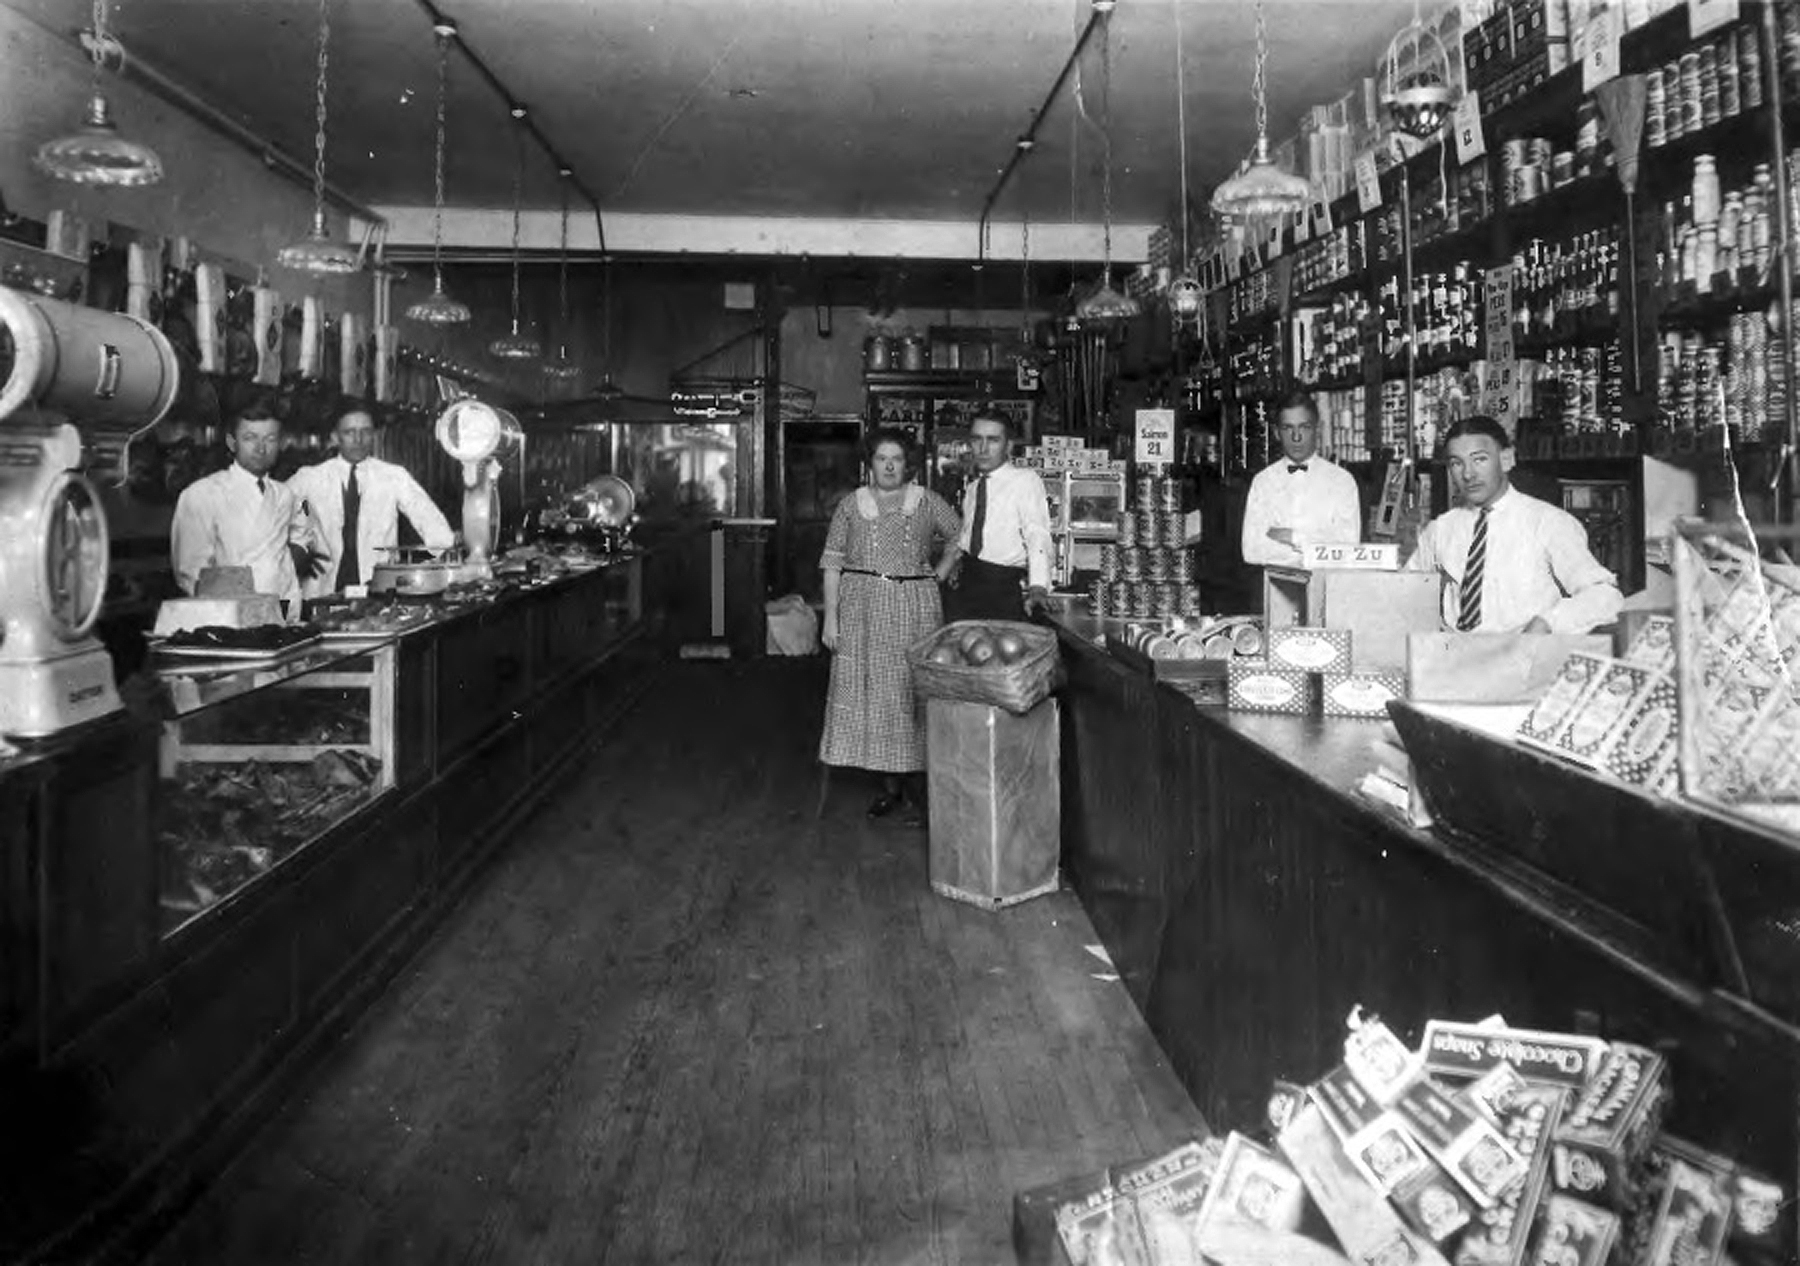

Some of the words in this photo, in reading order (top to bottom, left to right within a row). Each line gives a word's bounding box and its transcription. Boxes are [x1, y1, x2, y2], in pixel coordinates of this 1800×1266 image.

[1147, 441, 1161, 456] 21
[1432, 1032, 1485, 1061] Snaps
[1487, 1041, 1584, 1074] Chocolate
